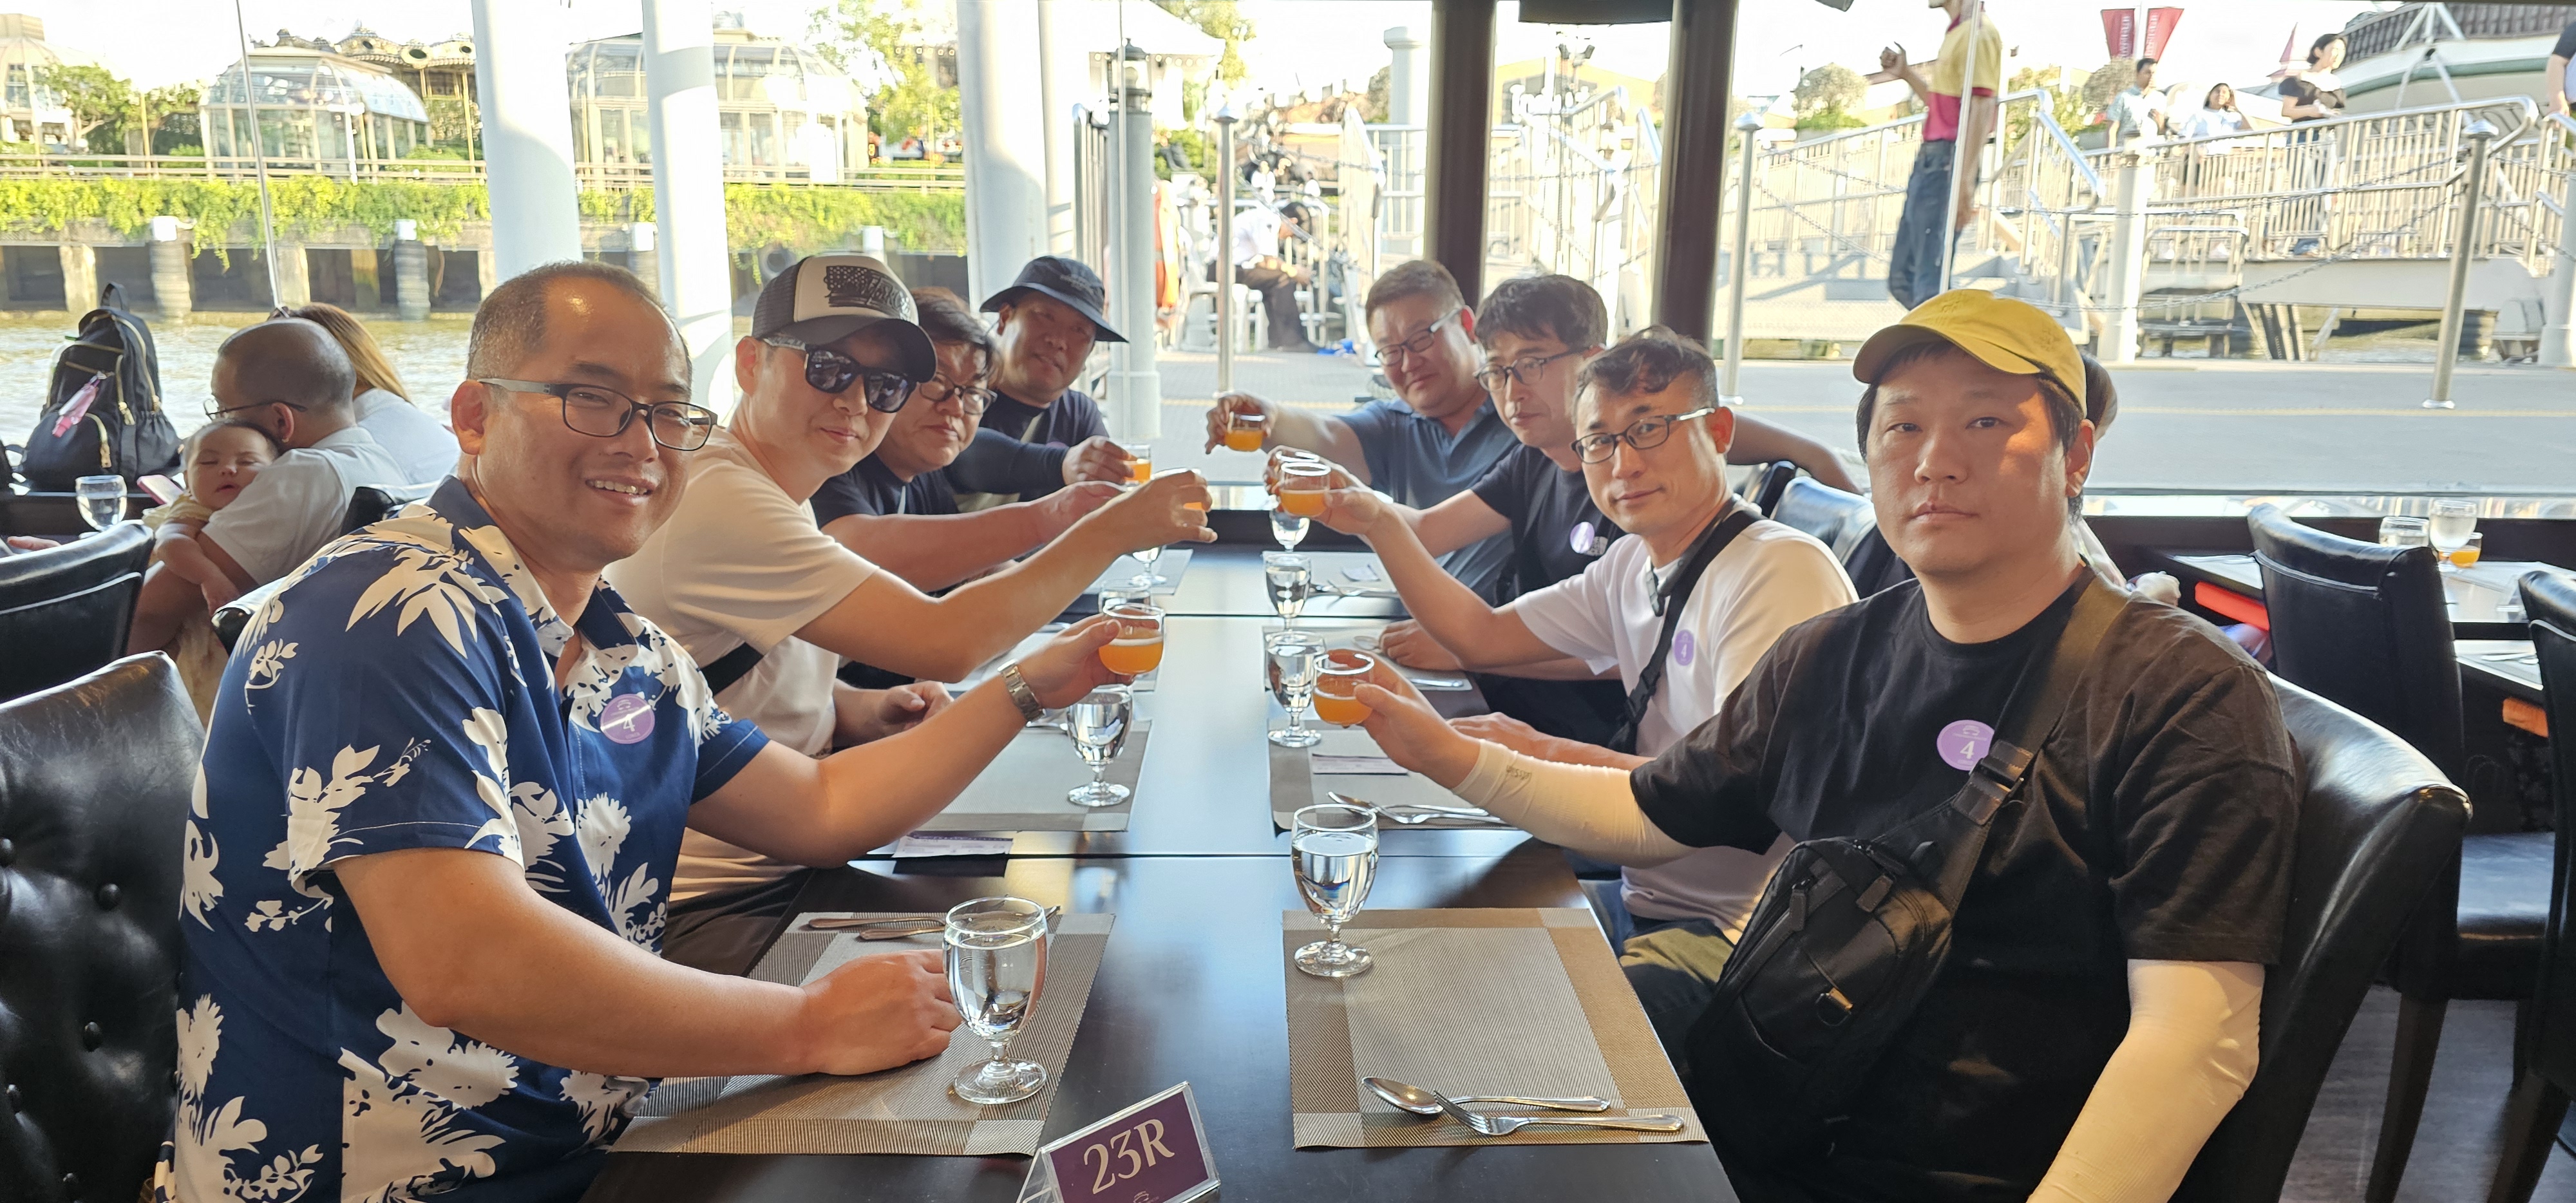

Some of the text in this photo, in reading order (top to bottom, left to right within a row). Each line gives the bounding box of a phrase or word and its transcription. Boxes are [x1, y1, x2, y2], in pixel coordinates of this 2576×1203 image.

[623, 714, 636, 732] 4
[1960, 740, 1975, 759] 4
[1084, 1119, 1175, 1195] 23R
